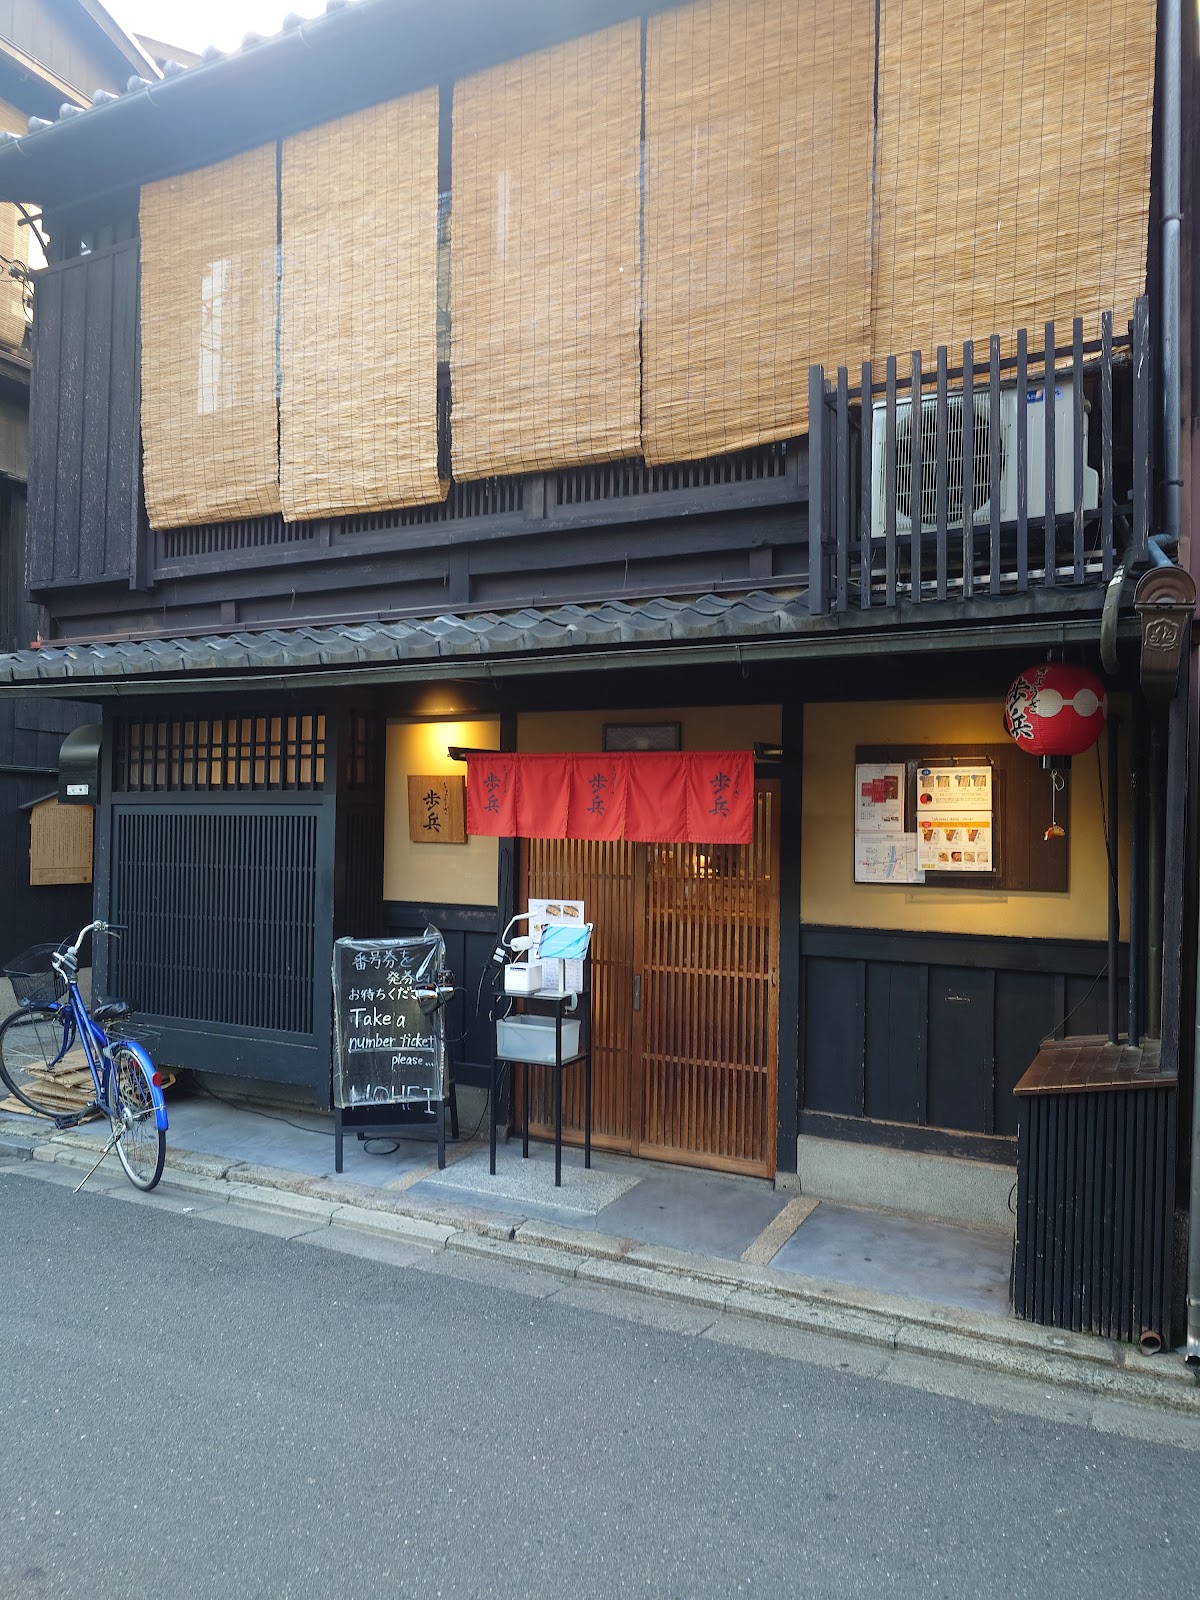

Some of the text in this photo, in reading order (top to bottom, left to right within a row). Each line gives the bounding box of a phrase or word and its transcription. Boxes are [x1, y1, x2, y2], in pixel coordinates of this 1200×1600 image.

[1007, 676, 1034, 740] 歩兵
[422, 788, 441, 833] 歩兵
[483, 772, 501, 813] 歩兵
[586, 772, 608, 816] 歩兵
[708, 771, 731, 817] 歩兵
[350, 1006, 406, 1028] Take a
[349, 1032, 435, 1049] number ticket
